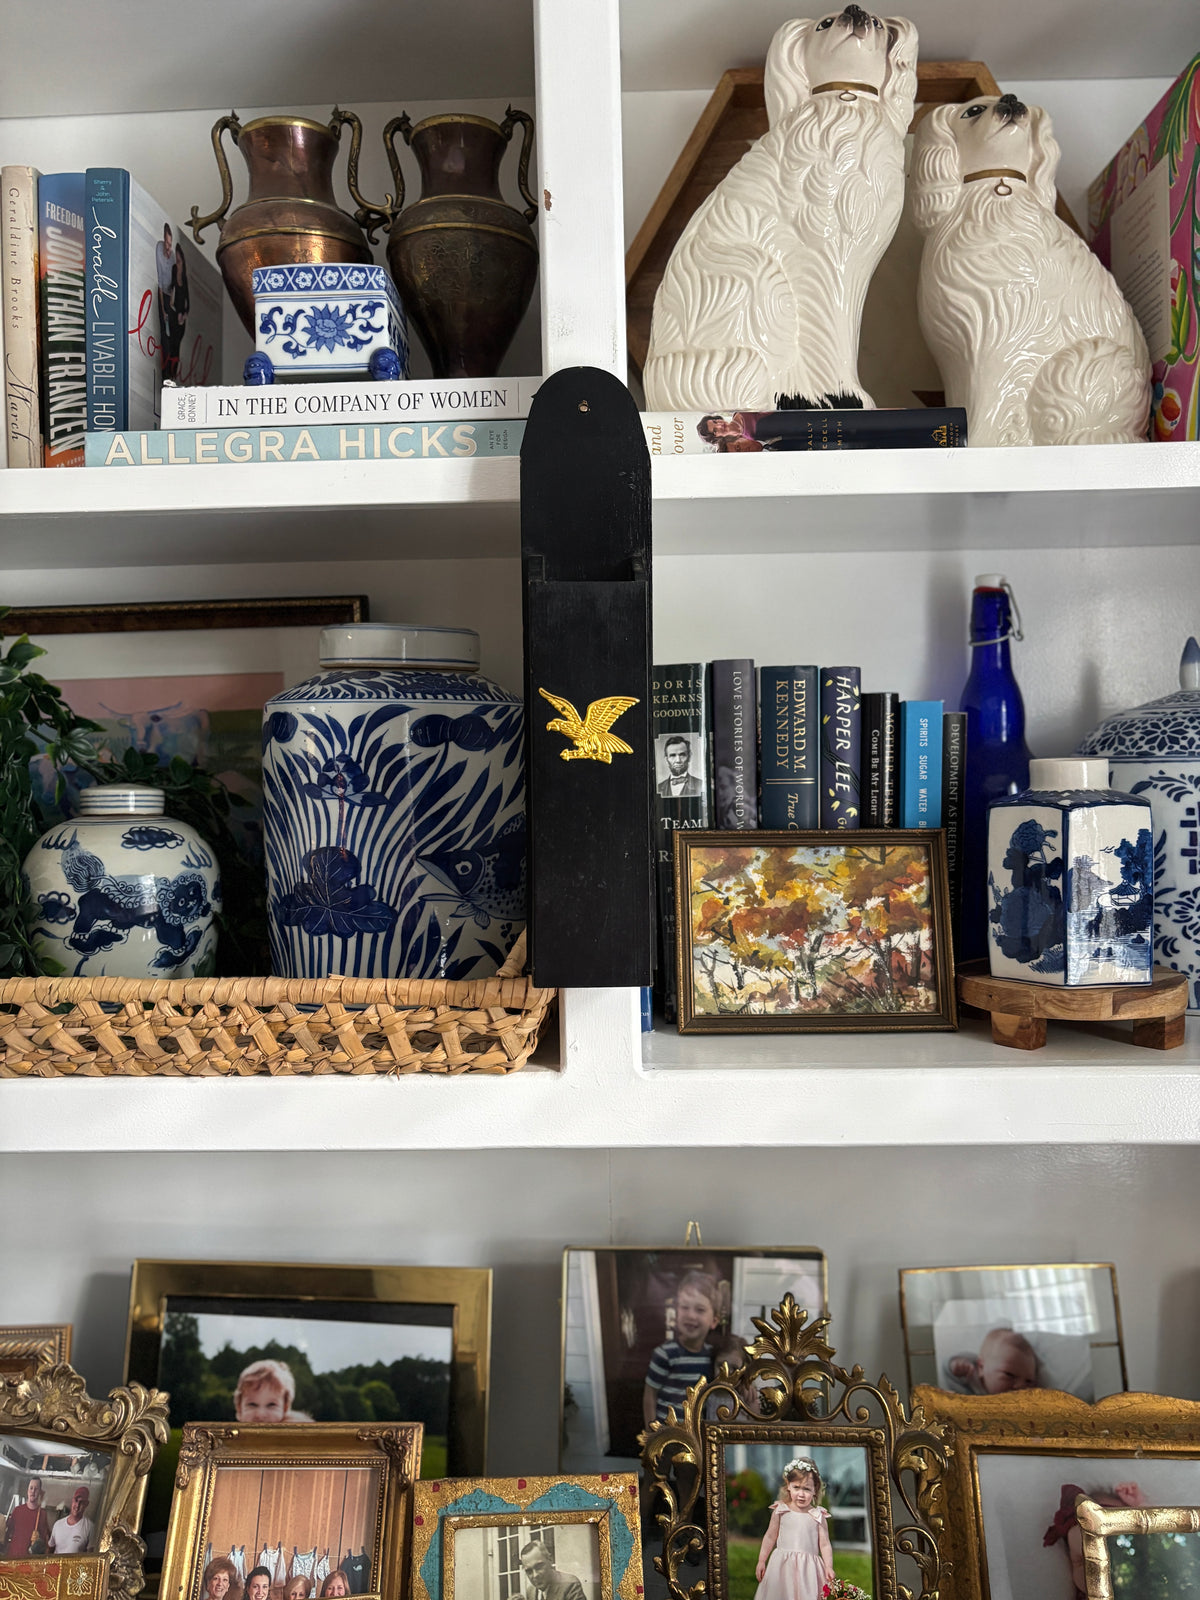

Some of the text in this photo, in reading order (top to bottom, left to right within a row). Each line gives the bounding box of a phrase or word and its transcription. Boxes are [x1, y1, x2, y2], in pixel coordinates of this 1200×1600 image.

[45, 201, 84, 231] FREEDOM
[9, 187, 22, 329] Geraldine Brooks
[91, 206, 118, 319] lovable
[46, 226, 86, 342] JONATHAN
[91, 322, 116, 395] LIVABLE
[6, 353, 39, 445] March
[49, 352, 87, 457] FRANZEN
[188, 393, 196, 422] BONNEY
[218, 389, 508, 417] IN THE COMPANY OF WOMEN
[104, 424, 477, 466] ALLEGRA HICKS
[671, 417, 684, 455] ower
[652, 679, 702, 690] DORIS
[652, 693, 702, 704] KEARNS
[732, 671, 743, 700] LOVE
[653, 708, 702, 718] GOODWIN
[733, 704, 743, 752] STORIES
[776, 680, 789, 769] KENNEDY
[793, 680, 806, 773] EDWARD M.
[835, 675, 851, 793] HARPER LEE
[919, 718, 928, 747] SPIRITS
[734, 756, 744, 771] OF
[919, 754, 928, 781] SUGAR
[948, 723, 960, 803] DEVELOPMENT
[735, 771, 745, 818] WORLD
[787, 792, 799, 819] True
[918, 788, 928, 813] WATER
[948, 804, 958, 818] AS
